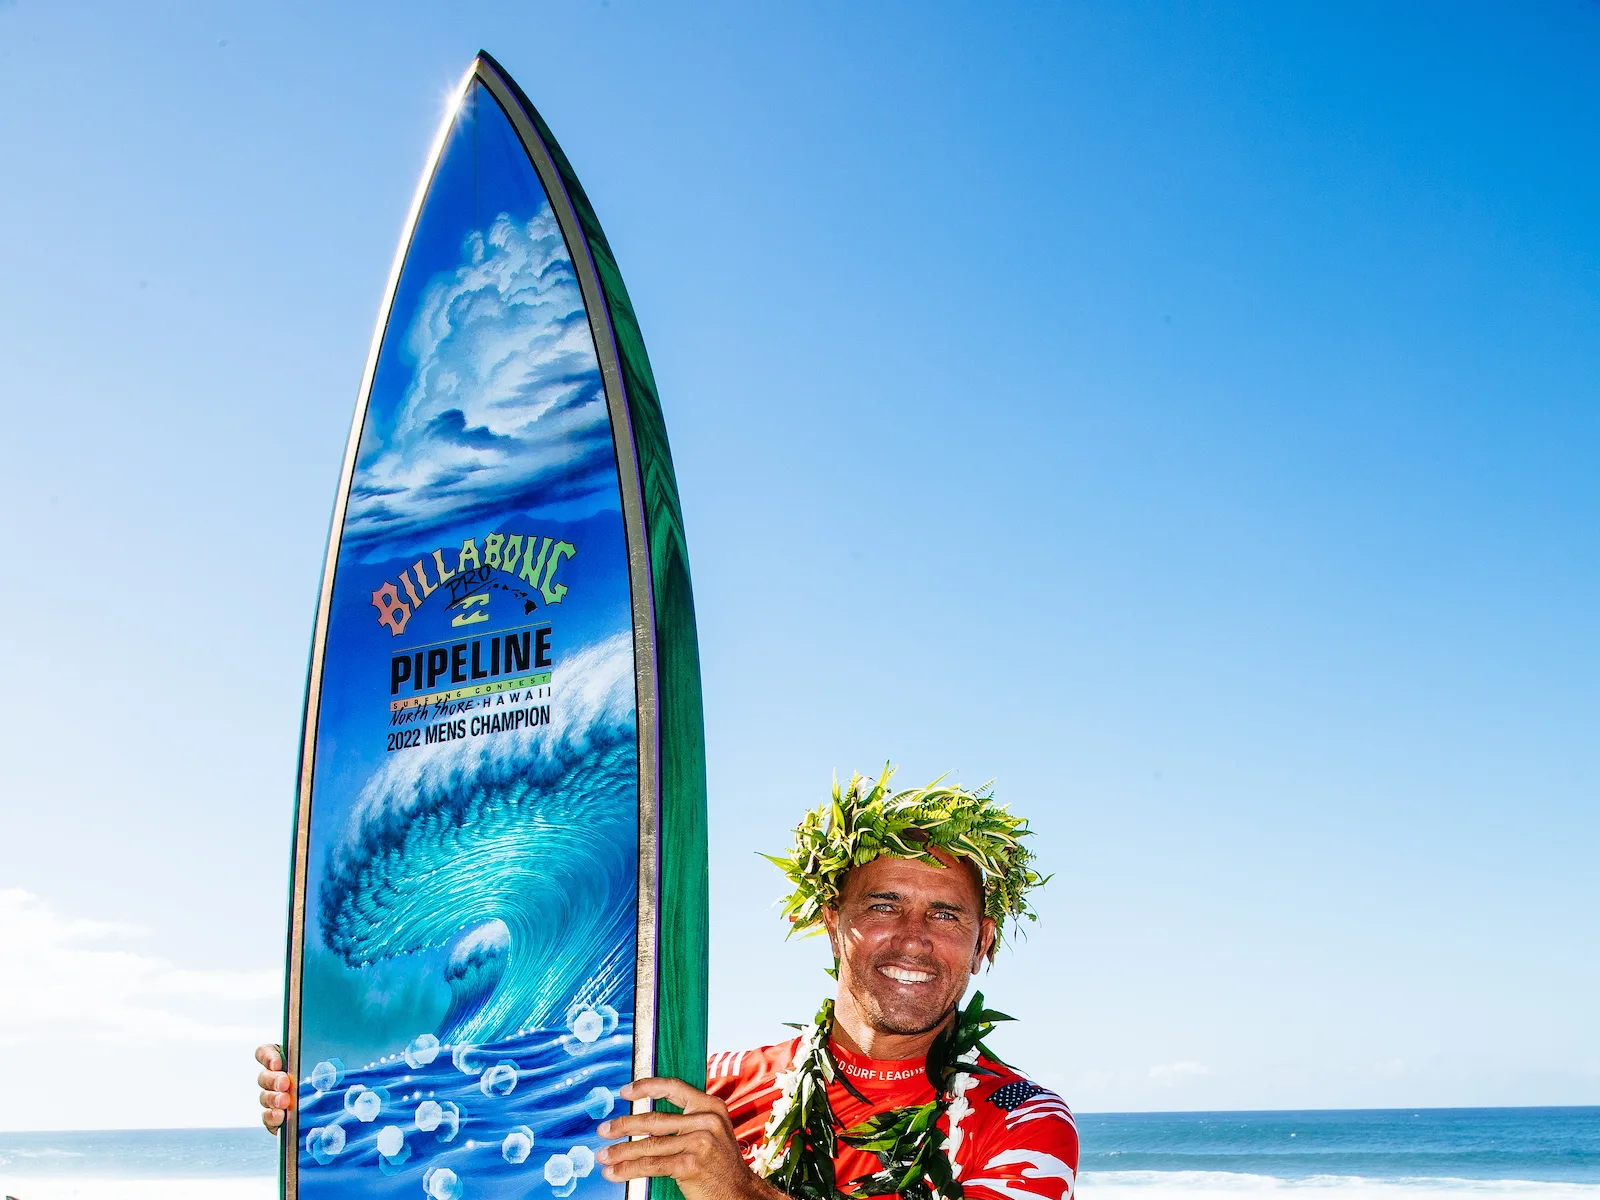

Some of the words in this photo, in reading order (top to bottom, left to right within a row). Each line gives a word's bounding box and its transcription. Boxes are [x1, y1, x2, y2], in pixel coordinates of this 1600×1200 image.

[371, 531, 577, 637] BILLABONG
[444, 563, 491, 604] PRO
[391, 627, 552, 695] PIPELINE
[392, 692, 461, 710] SURFING
[475, 676, 546, 694] CONTEST
[483, 686, 551, 708] HAWAII
[387, 729, 421, 751] 2022
[425, 718, 466, 744] MENS
[470, 705, 550, 736] CHAMPION
[846, 1064, 877, 1080] SURF
